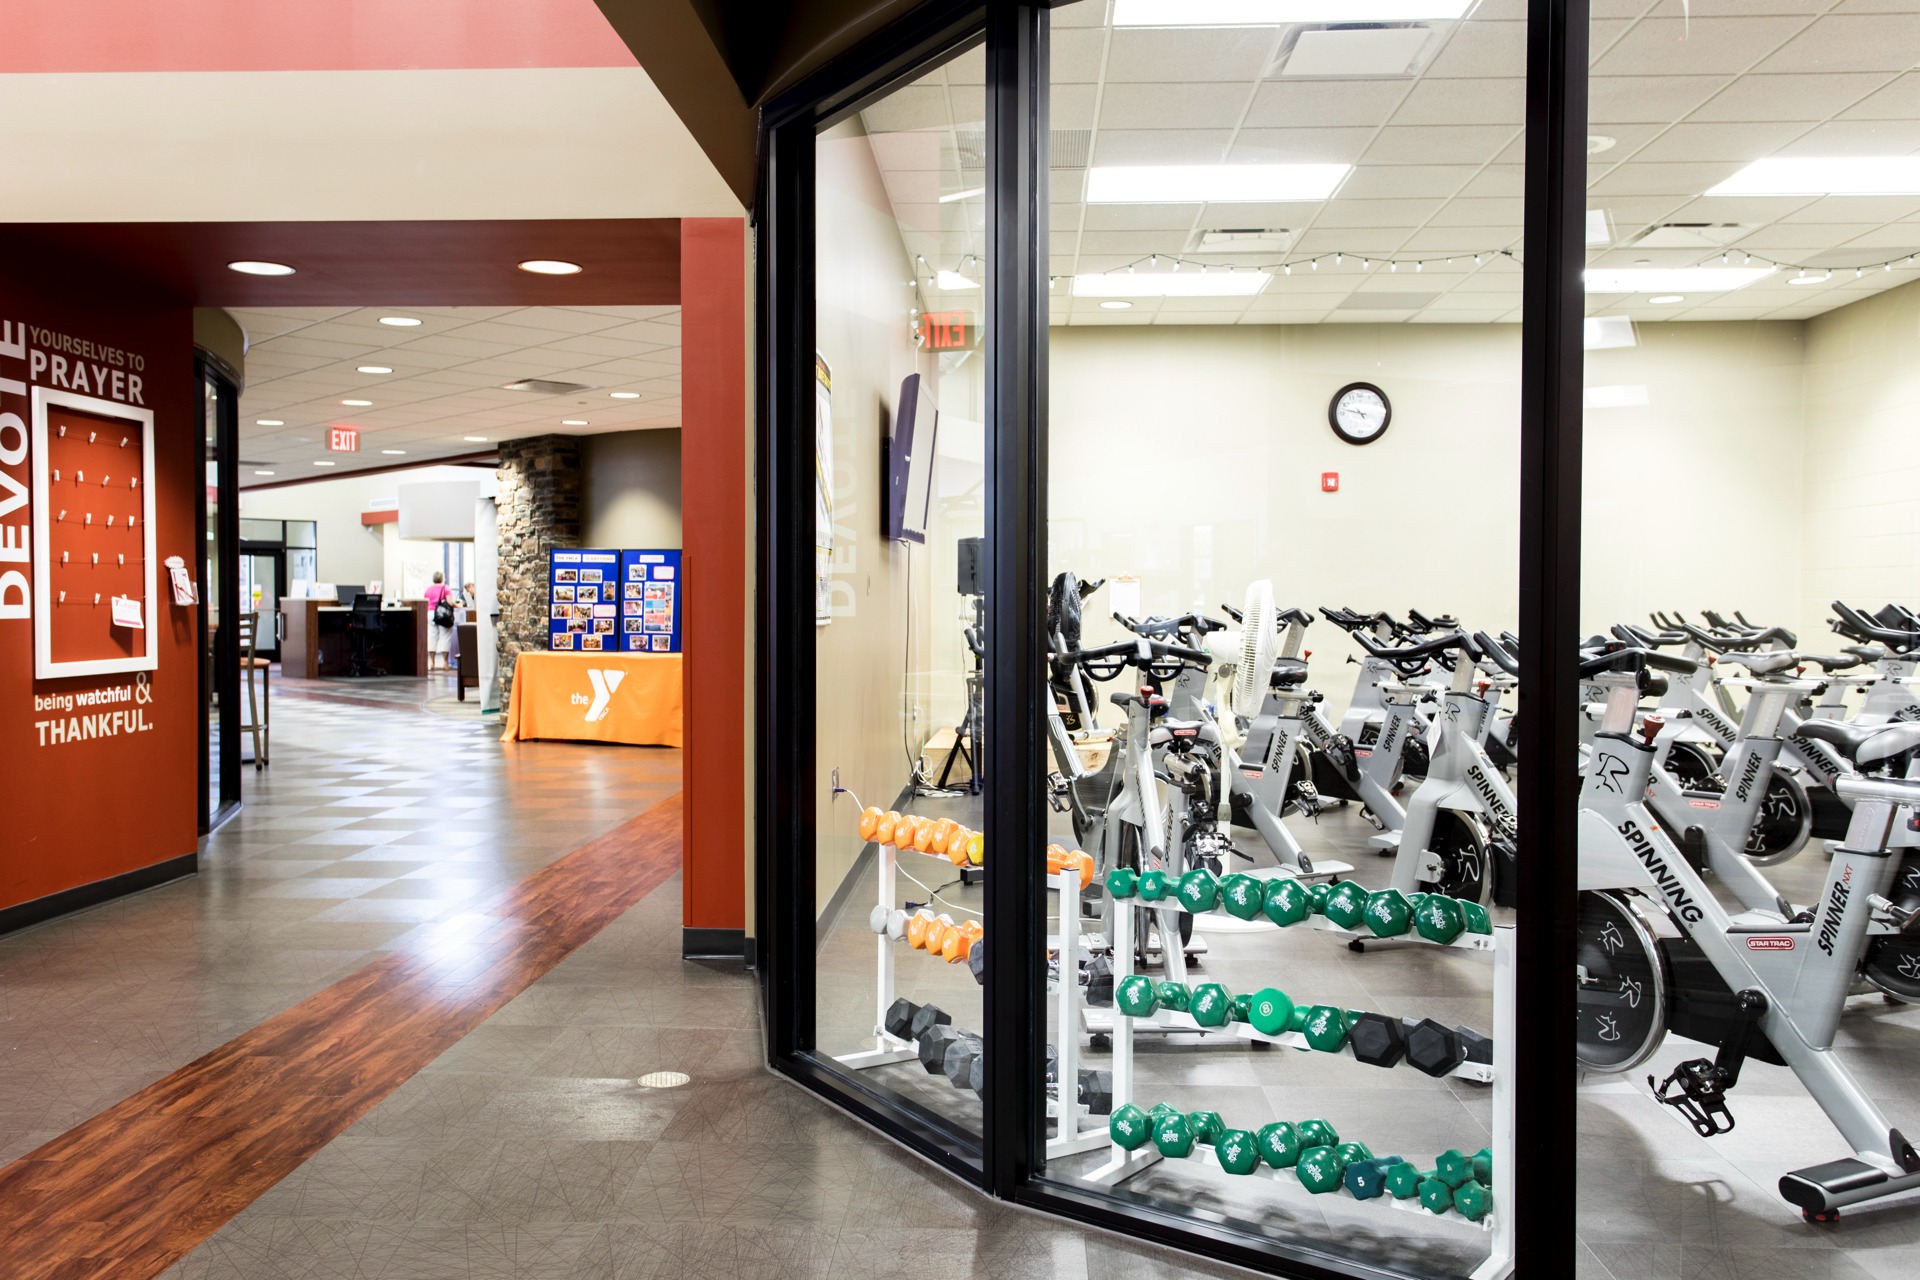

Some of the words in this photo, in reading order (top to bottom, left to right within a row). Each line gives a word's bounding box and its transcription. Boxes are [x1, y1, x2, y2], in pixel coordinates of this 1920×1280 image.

[30, 325, 125, 366] YOURSELVES
[126, 352, 145, 372] TO
[30, 348, 145, 405] PRAYER
[332, 430, 357, 451] EXIT
[35, 693, 73, 712] being
[76, 685, 131, 706] watchful
[135, 671, 153, 705] &
[571, 692, 589, 705] the
[35, 709, 153, 747] THANKFUL.
[1383, 714, 1401, 753] SPINNER
[1696, 708, 1738, 742] SPINNI
[1272, 730, 1288, 773] SPINNER
[1788, 732, 1838, 776] SPINNER
[1736, 752, 1762, 803] SPINNER
[1618, 820, 1703, 923] SPINNING
[1842, 863, 1853, 885] NXT
[1818, 881, 1850, 957] SPINNER
[1357, 1176, 1365, 1187] 5
